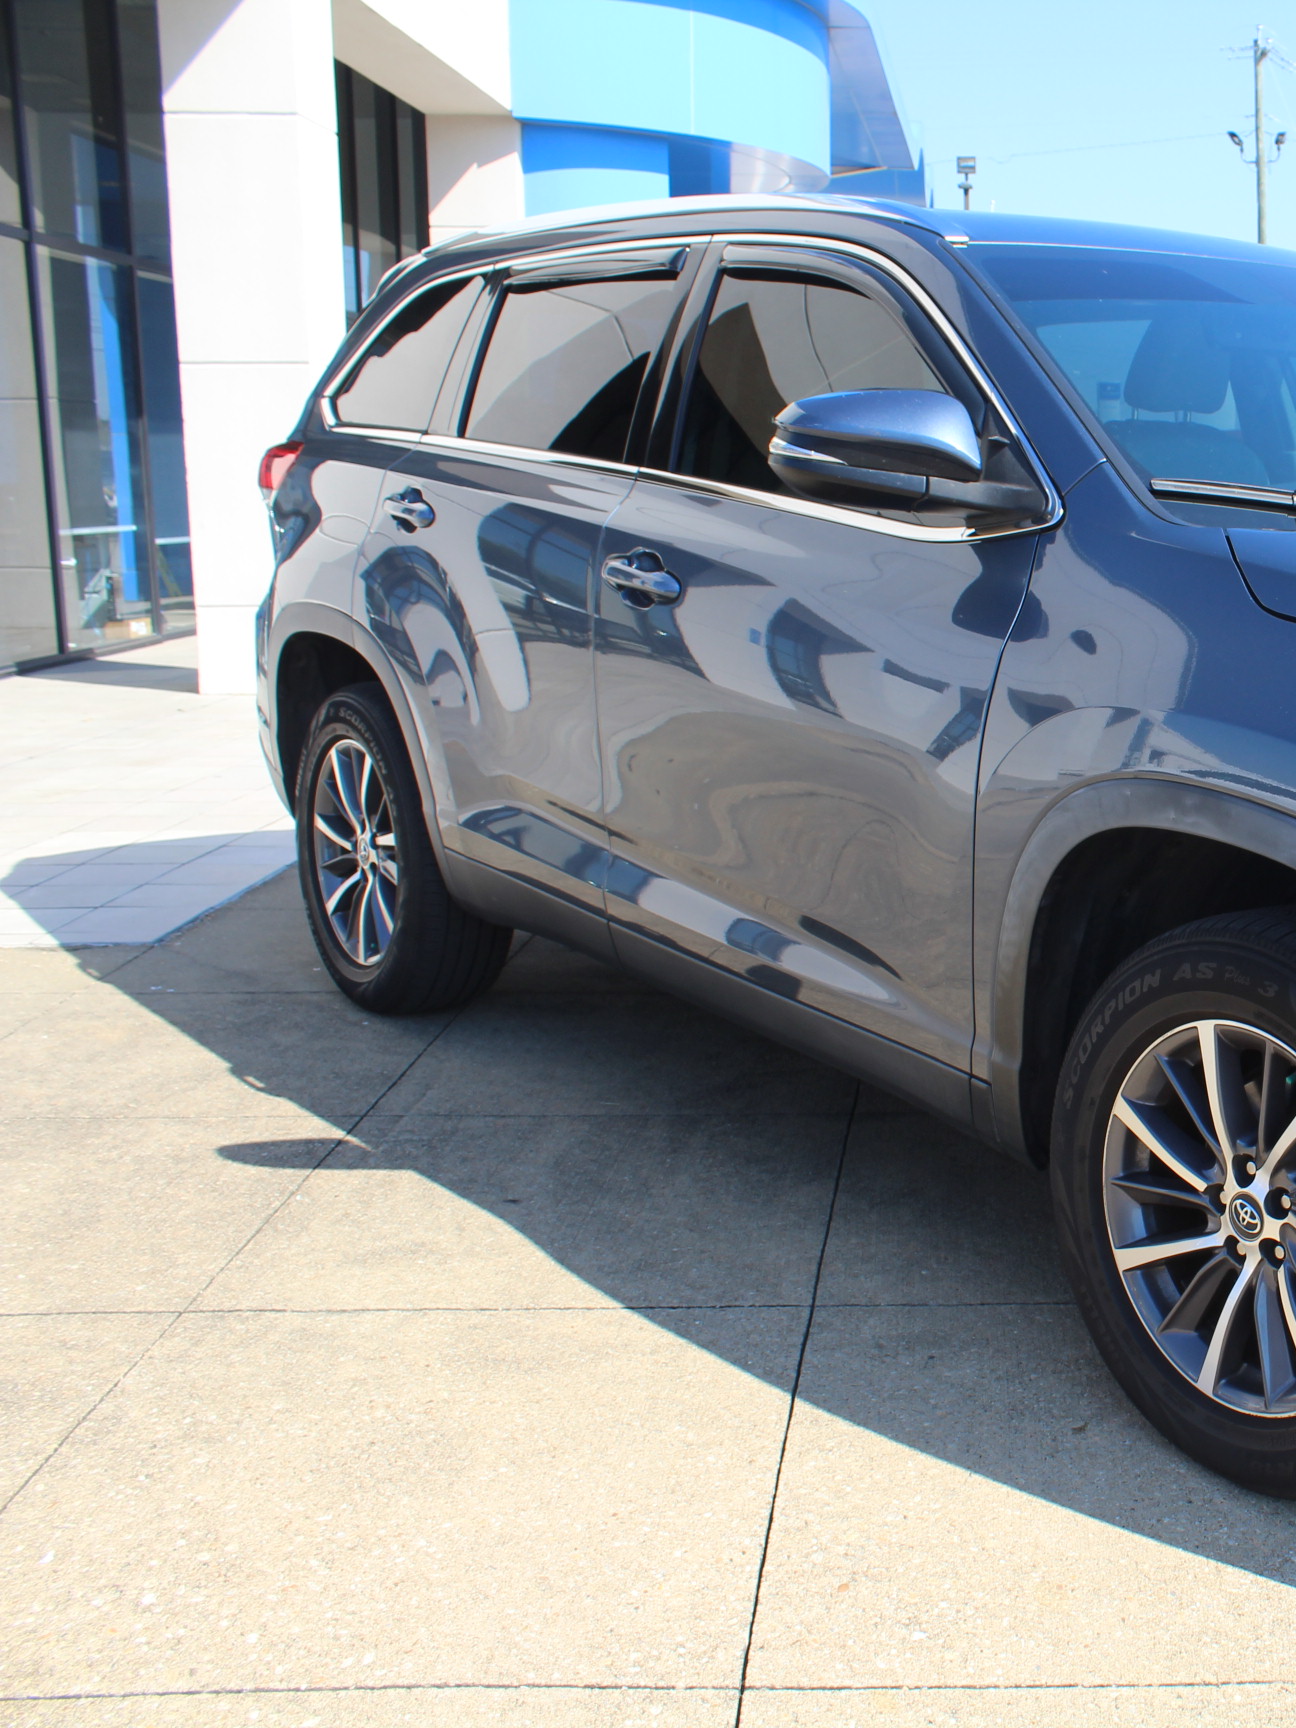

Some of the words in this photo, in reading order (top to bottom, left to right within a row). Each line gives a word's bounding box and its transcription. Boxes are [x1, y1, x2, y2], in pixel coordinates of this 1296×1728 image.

[338, 706, 388, 775] SCORPION
[1061, 968, 1162, 1110] SCORPION
[1172, 961, 1218, 981] AS
